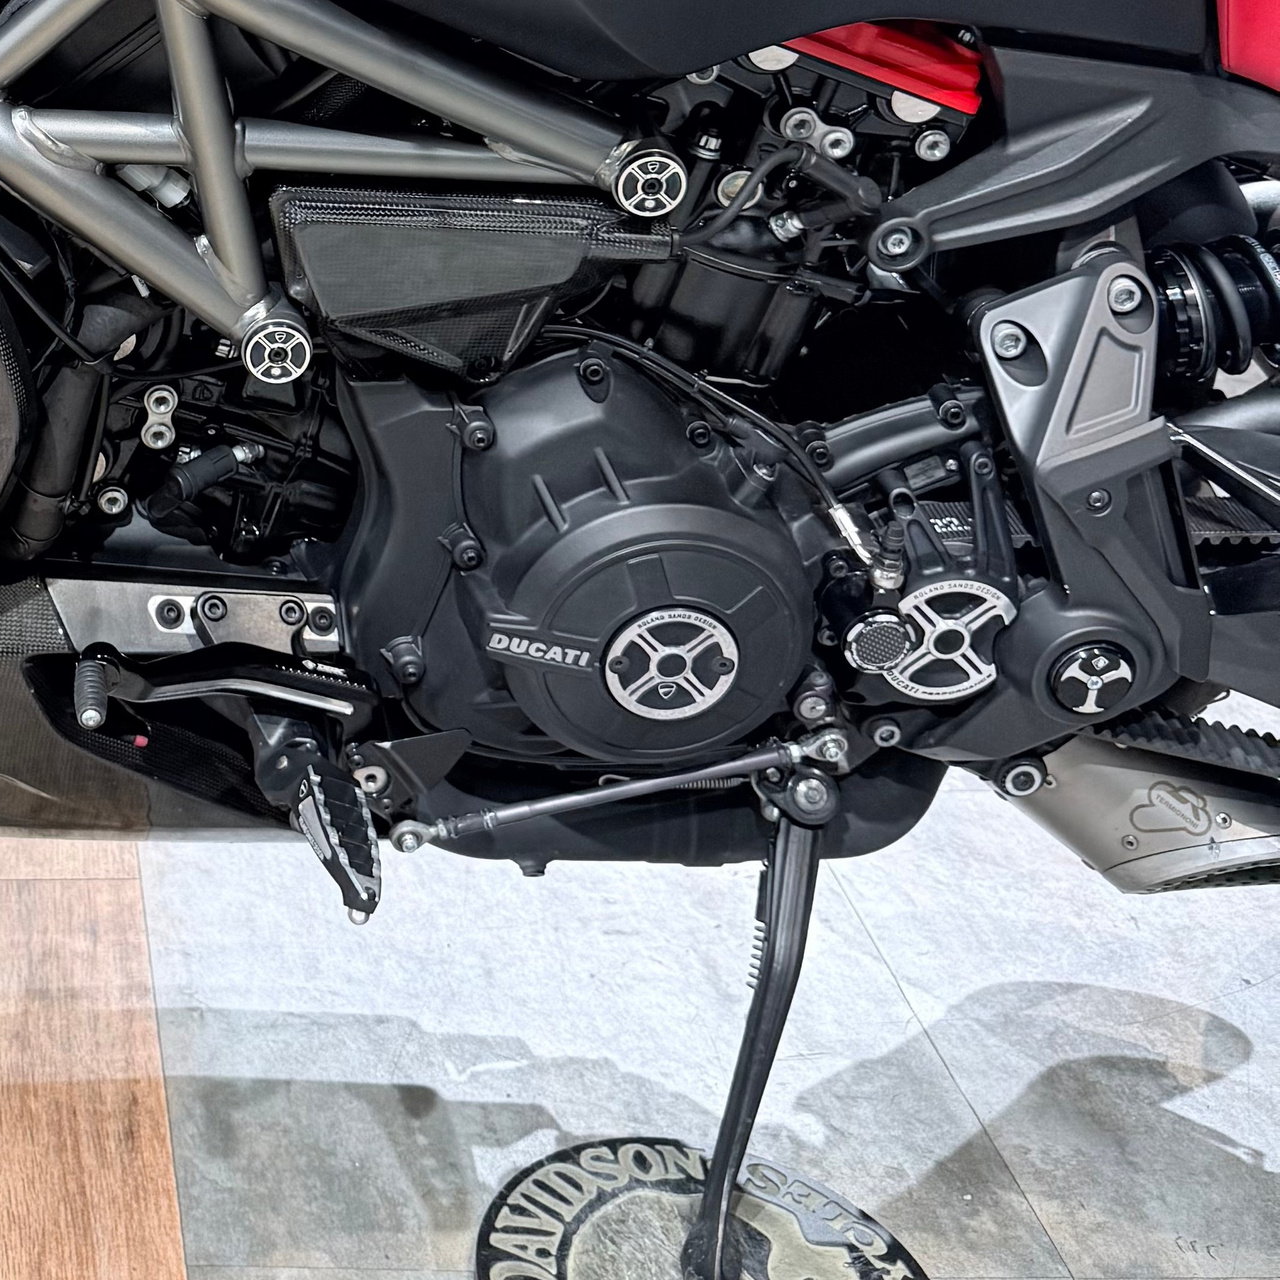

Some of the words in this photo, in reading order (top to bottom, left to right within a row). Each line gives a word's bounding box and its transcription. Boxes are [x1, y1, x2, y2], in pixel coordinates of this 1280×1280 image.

[913, 584, 945, 601] ROLAND
[947, 582, 975, 590] SANDS
[976, 585, 1002, 601] DESIGN
[488, 633, 591, 667] DUCATI
[886, 670, 920, 694] DUCATI
[1155, 793, 1199, 829] TERMIGNONI
